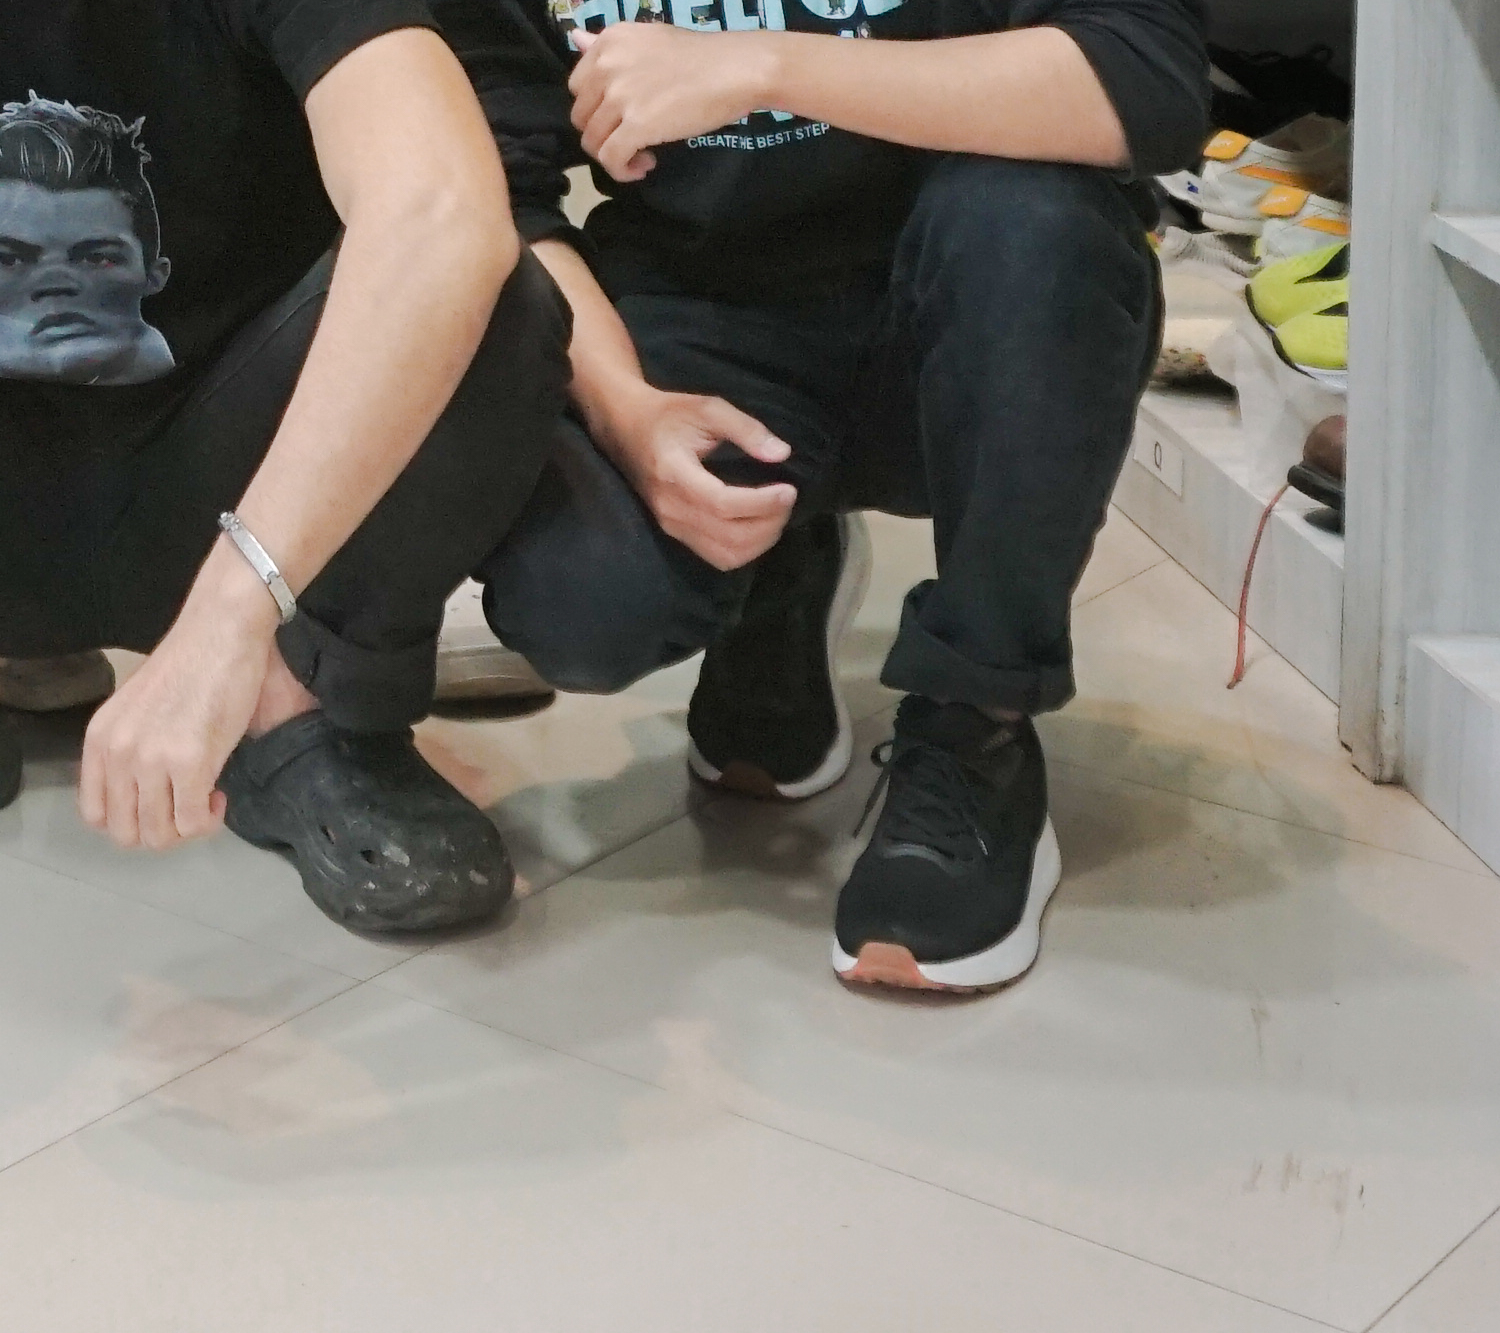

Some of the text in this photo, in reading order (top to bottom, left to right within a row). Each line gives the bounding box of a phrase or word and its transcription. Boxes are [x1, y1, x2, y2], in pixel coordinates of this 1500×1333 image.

[687, 134, 740, 150] CREATE
[756, 131, 791, 150] BEST
[795, 121, 830, 140] STEP
